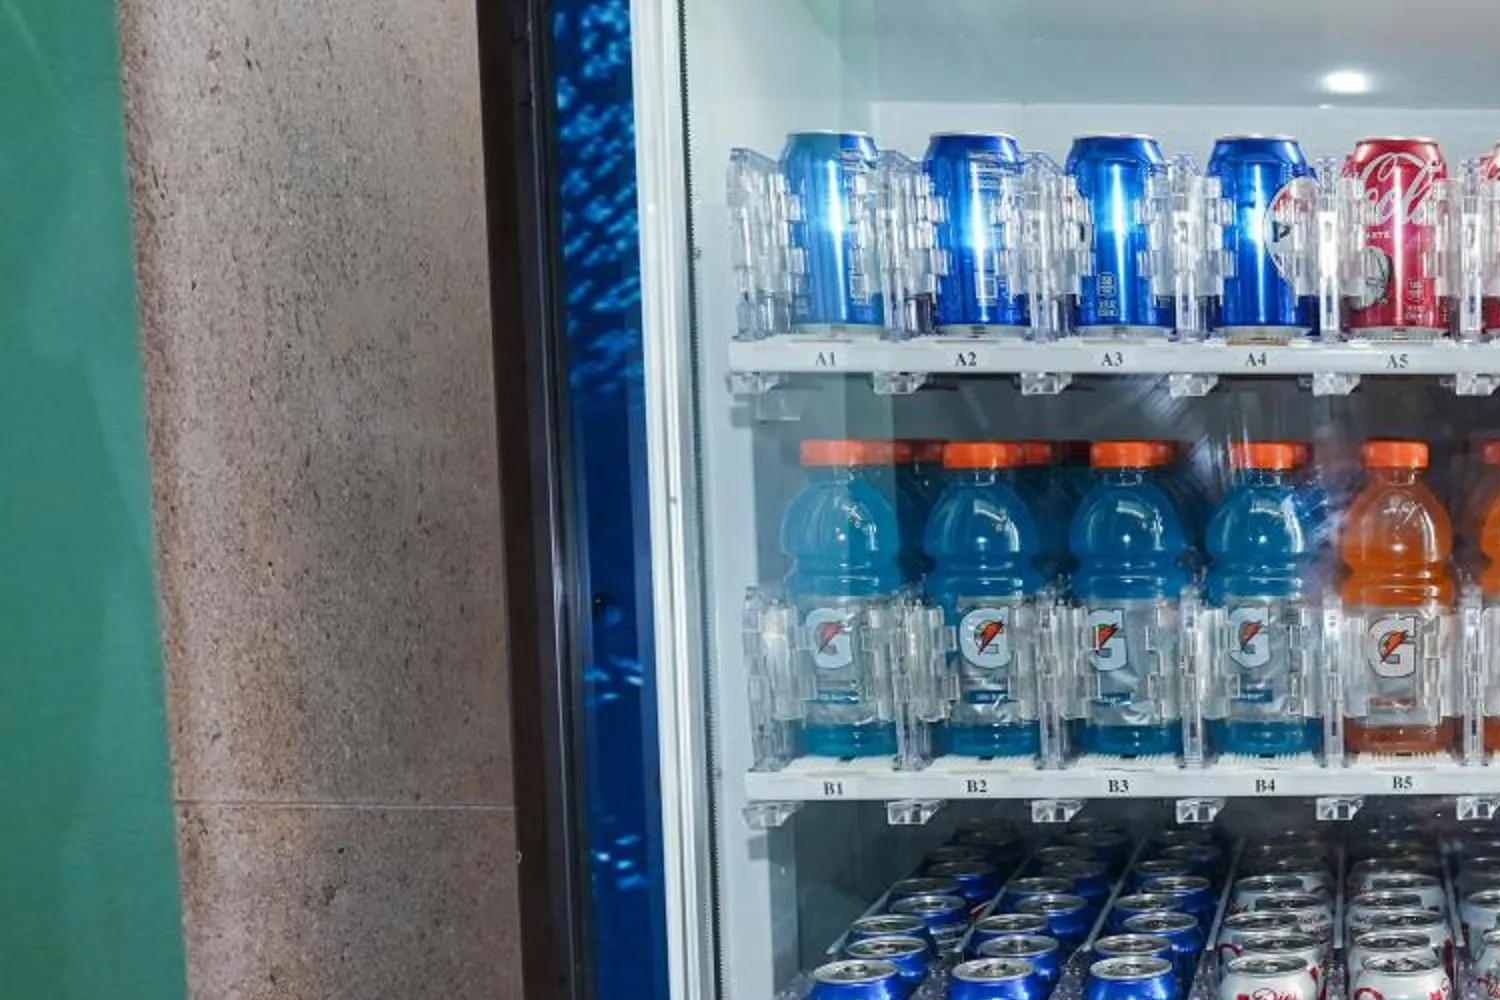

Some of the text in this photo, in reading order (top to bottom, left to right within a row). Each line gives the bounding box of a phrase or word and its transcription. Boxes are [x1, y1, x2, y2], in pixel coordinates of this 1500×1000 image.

[816, 351, 835, 367] A1
[956, 351, 977, 367] A2
[1101, 351, 1123, 367] A3
[1246, 352, 1267, 367] A4
[1387, 353, 1409, 369] A5
[959, 607, 1012, 669] G
[1368, 616, 1417, 678] G
[823, 781, 843, 796] B1
[967, 779, 988, 793] B2
[1108, 779, 1129, 793] B3
[1255, 778, 1276, 793] B4
[1393, 775, 1413, 790] B5
